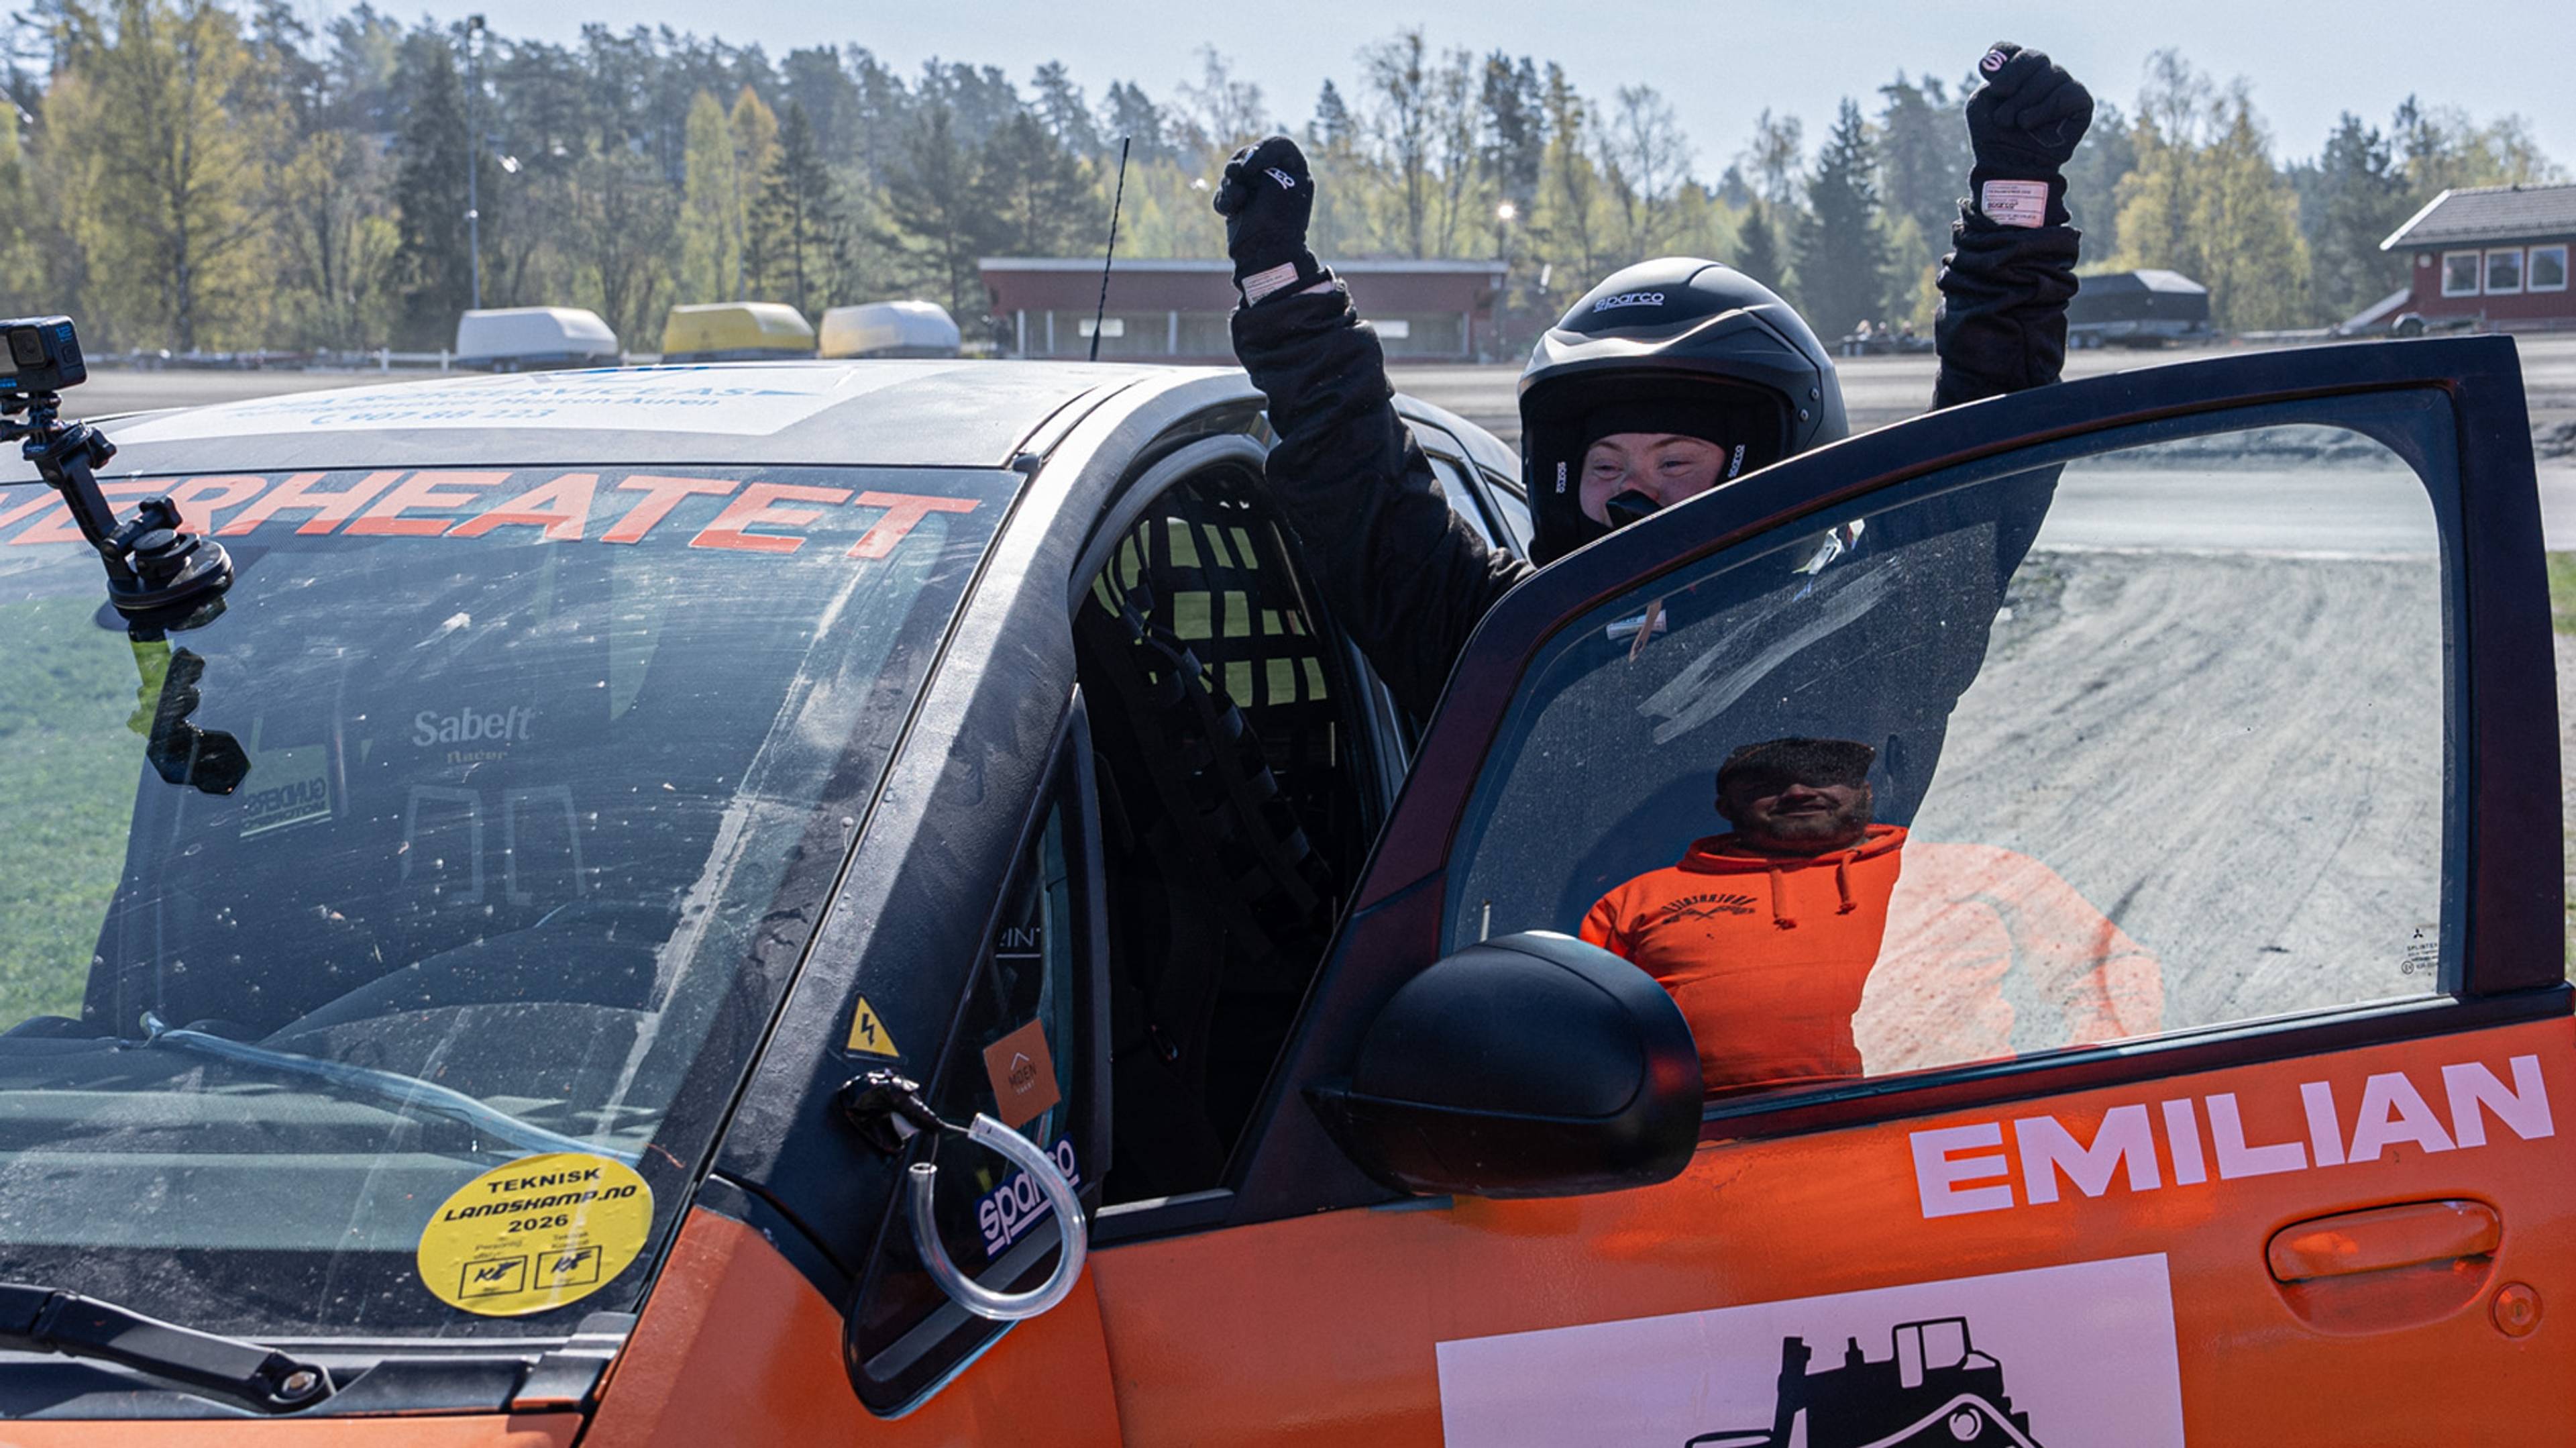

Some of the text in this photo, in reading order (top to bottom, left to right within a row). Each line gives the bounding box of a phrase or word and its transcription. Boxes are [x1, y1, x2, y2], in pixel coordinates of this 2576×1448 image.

[1593, 291, 1665, 313] sparco
[412, 705, 537, 747] Sabelt
[1909, 1054, 2555, 1219] EMILIAN
[488, 1168, 601, 1194] TEKNISK
[508, 1214, 569, 1233] 2026
